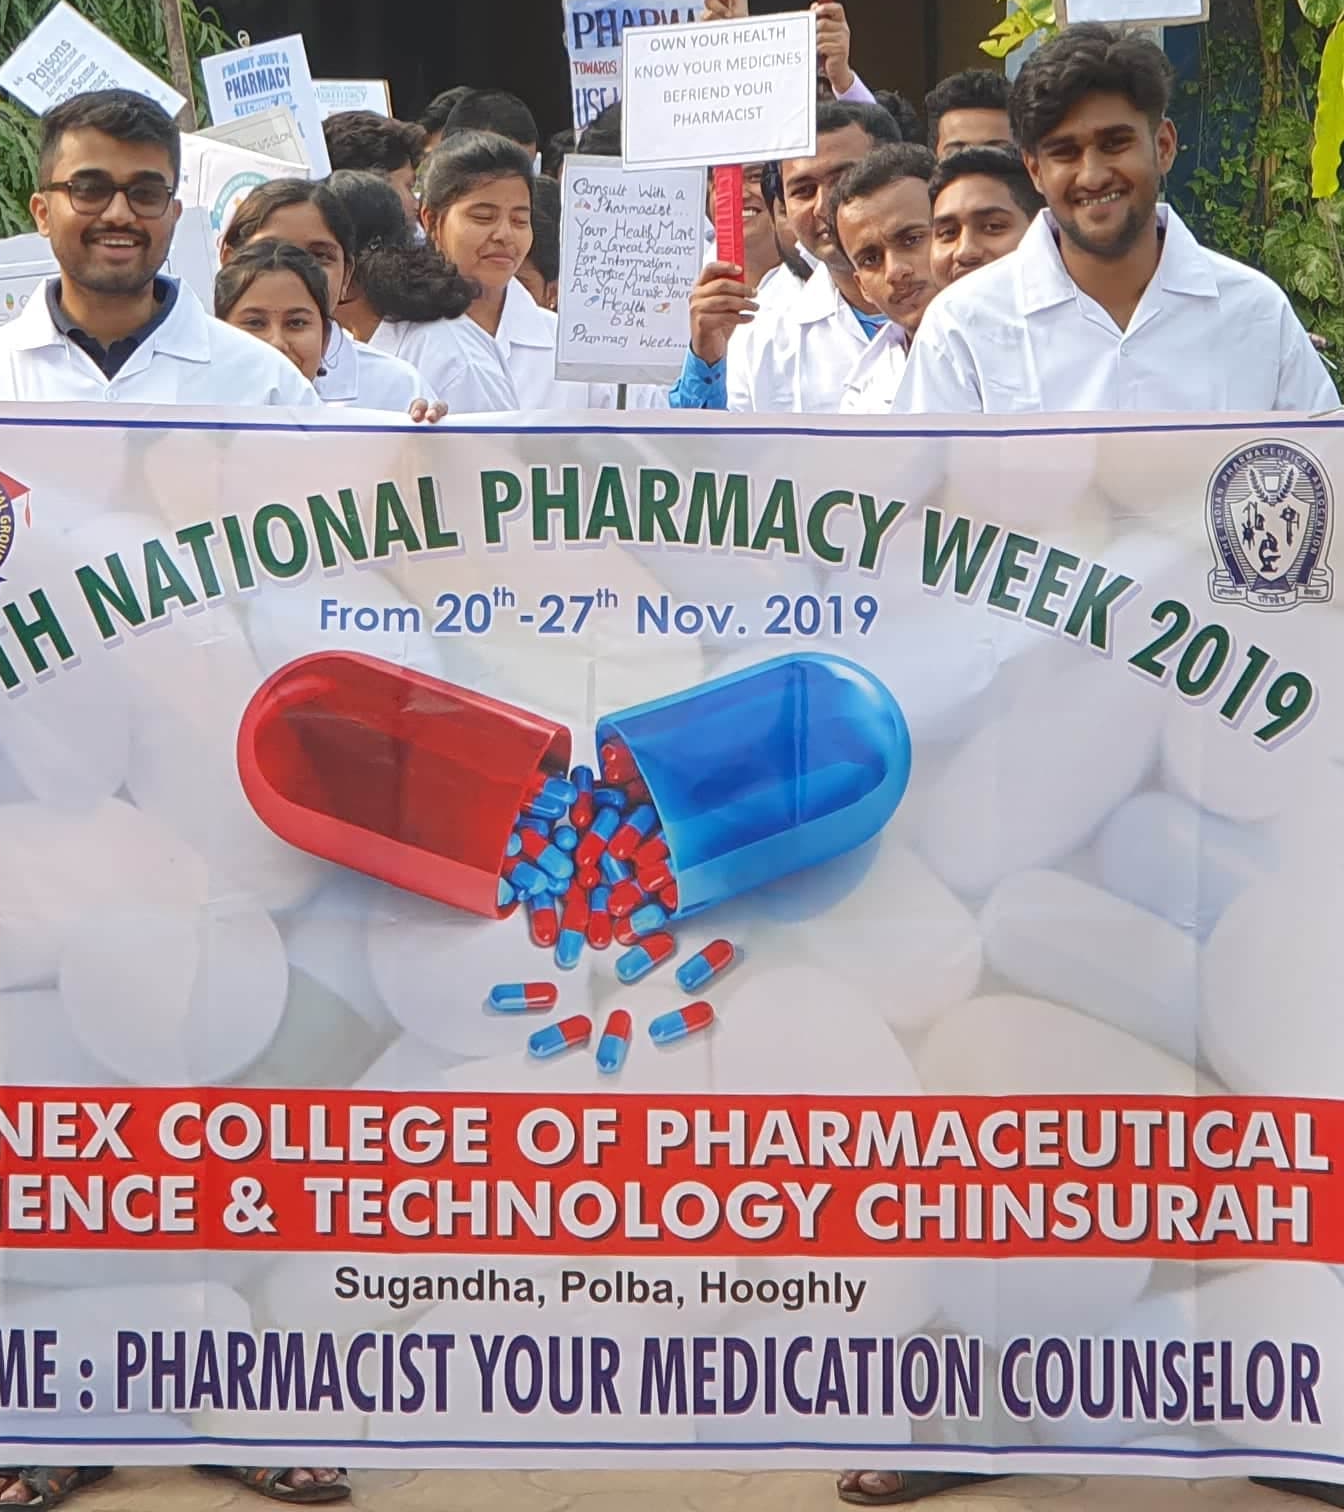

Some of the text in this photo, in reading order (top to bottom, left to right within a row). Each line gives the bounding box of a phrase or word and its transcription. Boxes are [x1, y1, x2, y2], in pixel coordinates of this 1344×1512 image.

[650, 26, 786, 52] OWN YOUR HEALTH
[26, 40, 72, 90] Poisons
[573, 60, 617, 75] TOWARDS
[634, 52, 802, 79] KNOW YOUR MEDICINES
[225, 66, 291, 102] PHARMACY
[663, 81, 773, 103] BEFRIEND YOUR
[673, 106, 763, 127] PHARMACIST
[573, 177, 686, 200] Consult With a
[575, 216, 607, 241] Your
[1221, 446, 1313, 483] PHARMACEUTICAL
[73, 475, 459, 642] NATIONAL
[481, 465, 906, 572] PHARMACY
[920, 508, 1135, 652] WEEK
[1127, 599, 1314, 745] 2019
[320, 598, 420, 634] From
[637, 594, 747, 635] Nov.
[764, 594, 878, 636] 2019
[158, 1102, 487, 1166] COLLEGE
[516, 1108, 617, 1166] OF
[646, 1108, 1330, 1172] PHARMACEUTICAL
[222, 1175, 278, 1236] &
[304, 1178, 833, 1240] TECHNOLOGY
[856, 1180, 1310, 1244] CHINSURAH
[334, 1266, 867, 1313] Sugandha, Polba, Hooghly
[115, 1329, 456, 1414] PHARMACIST
[470, 1333, 622, 1417] YOUR
[640, 1335, 981, 1419] MEDICATION
[1000, 1338, 1323, 1427] COUNSELOR
